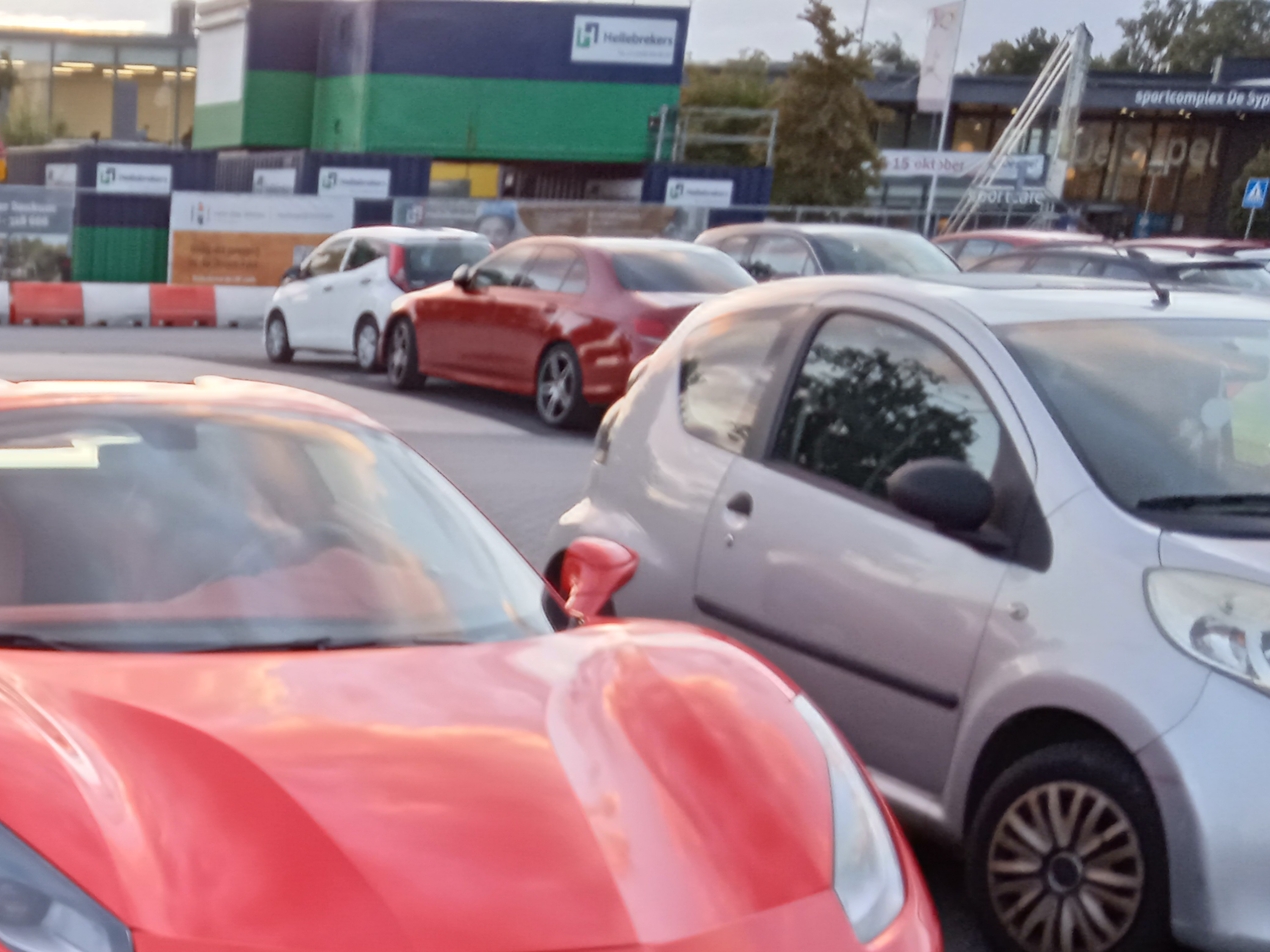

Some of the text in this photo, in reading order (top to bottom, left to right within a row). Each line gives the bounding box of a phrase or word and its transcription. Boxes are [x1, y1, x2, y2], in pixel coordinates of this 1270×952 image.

[603, 32, 674, 46] Hellebrekers
[1135, 88, 1270, 110] sportcomplex De Syp
